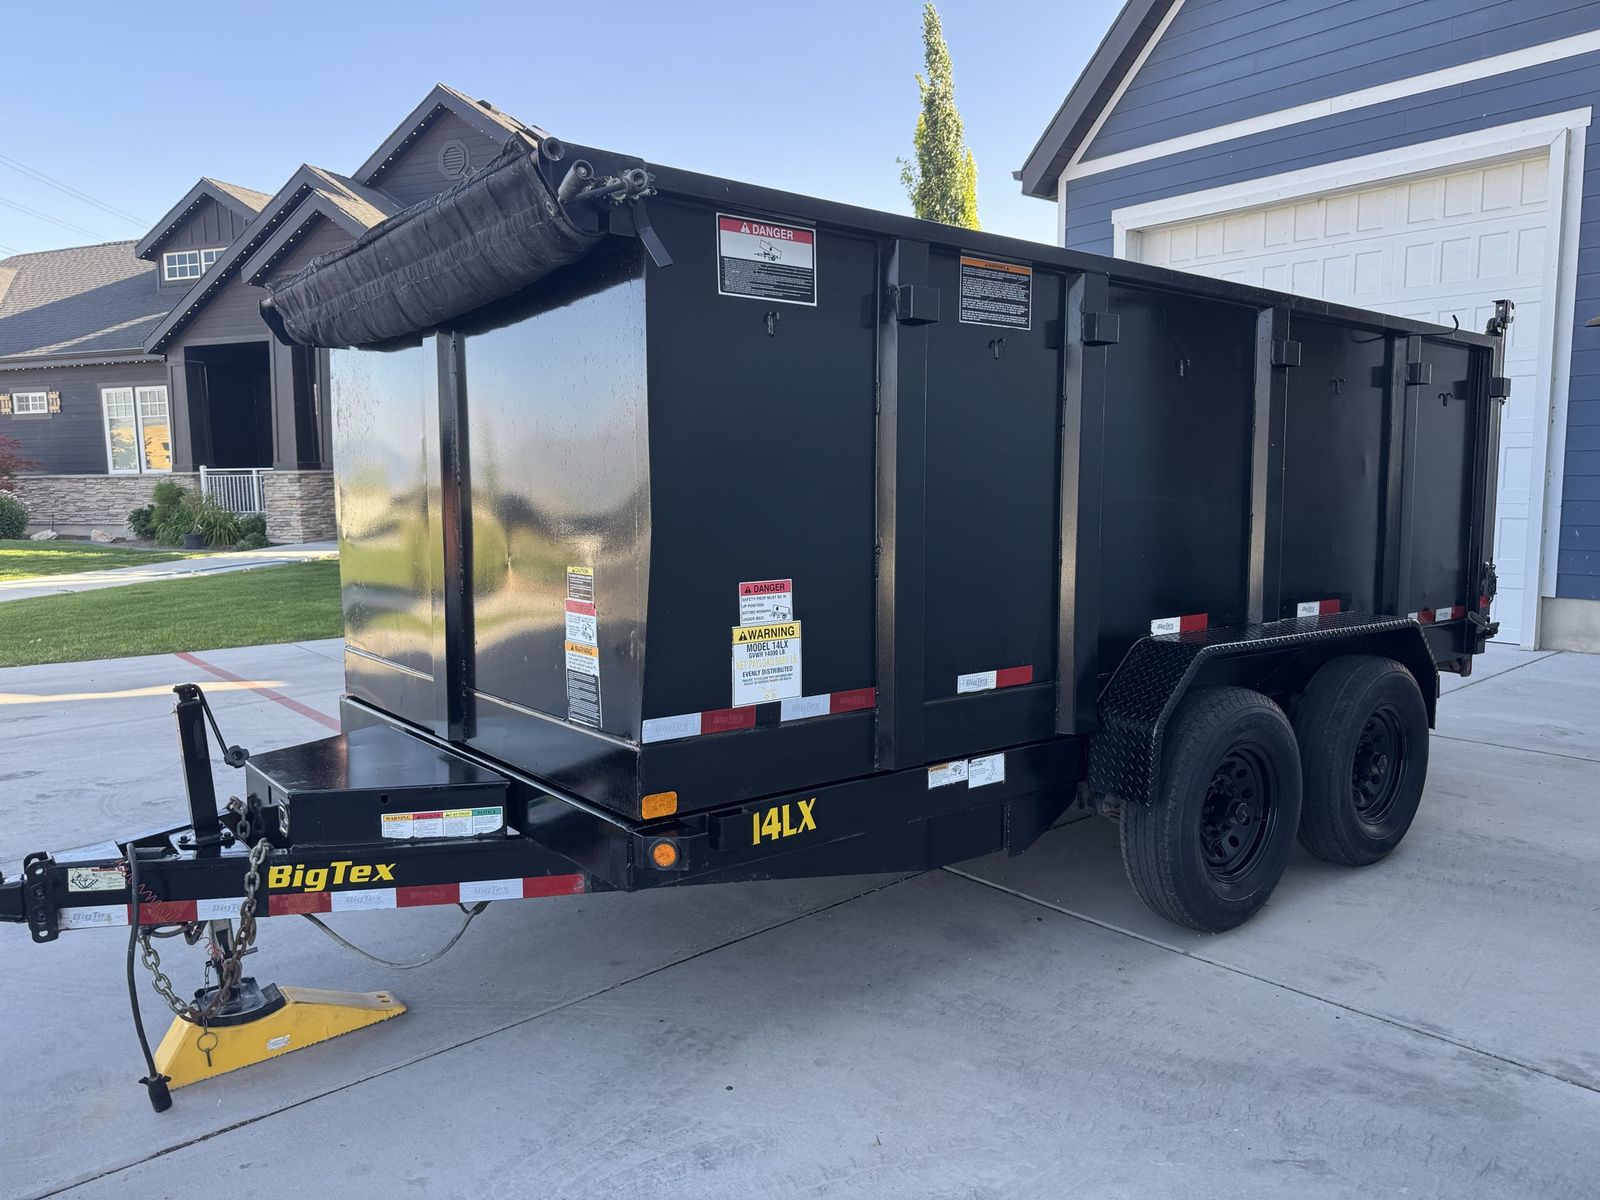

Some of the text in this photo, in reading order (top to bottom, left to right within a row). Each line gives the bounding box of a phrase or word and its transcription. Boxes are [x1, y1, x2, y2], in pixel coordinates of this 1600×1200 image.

[752, 224, 794, 240] DANGER
[753, 583, 785, 593] DANGER
[747, 626, 795, 640] WARNING
[746, 640, 789, 653] MODEL 14LX
[748, 651, 764, 659] GVWR
[742, 665, 794, 678] EVENLY DISTRIBUTED
[752, 797, 817, 845] 14LX
[268, 860, 397, 893] BigTex
[72, 910, 112, 922] BigTex
[345, 894, 383, 904] BigTex
[473, 885, 510, 895] BigTex
